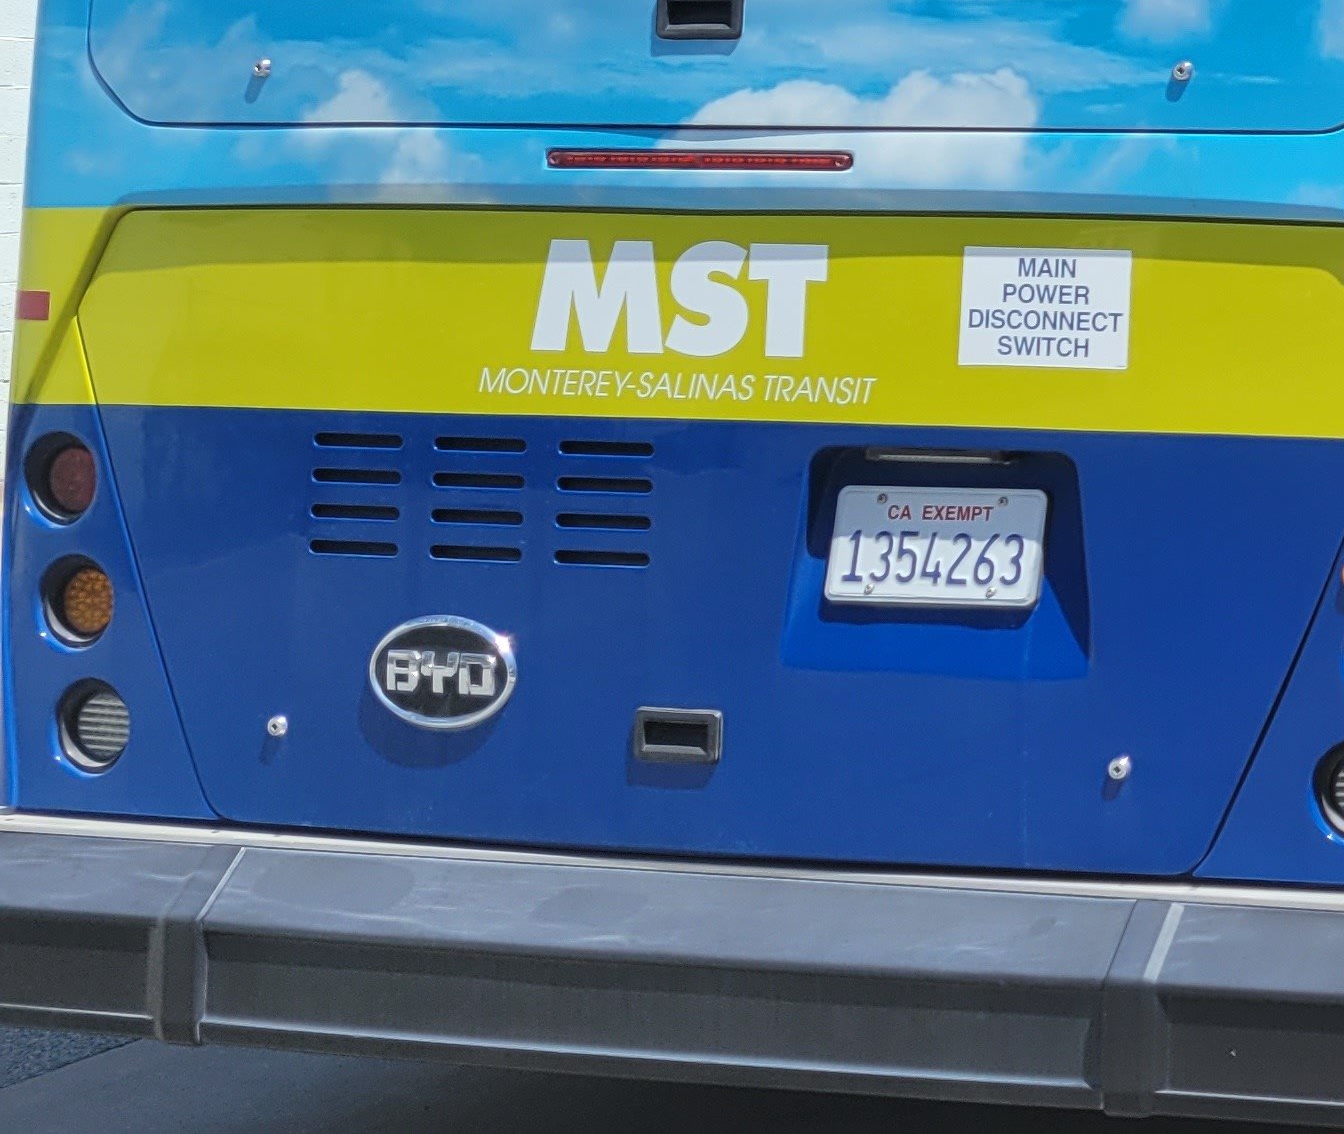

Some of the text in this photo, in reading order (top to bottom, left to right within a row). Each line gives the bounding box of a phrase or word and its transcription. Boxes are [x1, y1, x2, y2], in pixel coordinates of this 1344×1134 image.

[1018, 257, 1078, 279] MAIN
[530, 238, 829, 358] MST
[1002, 282, 1090, 306] POWER
[967, 309, 1124, 334] DISCONNECT
[996, 335, 1091, 359] SWITCH
[478, 367, 877, 405] MONTEREY-SALINAS TRANSIT
[887, 504, 995, 523] CA EXEMPT
[841, 529, 1025, 587] 1354263
[386, 649, 496, 696] BYD
